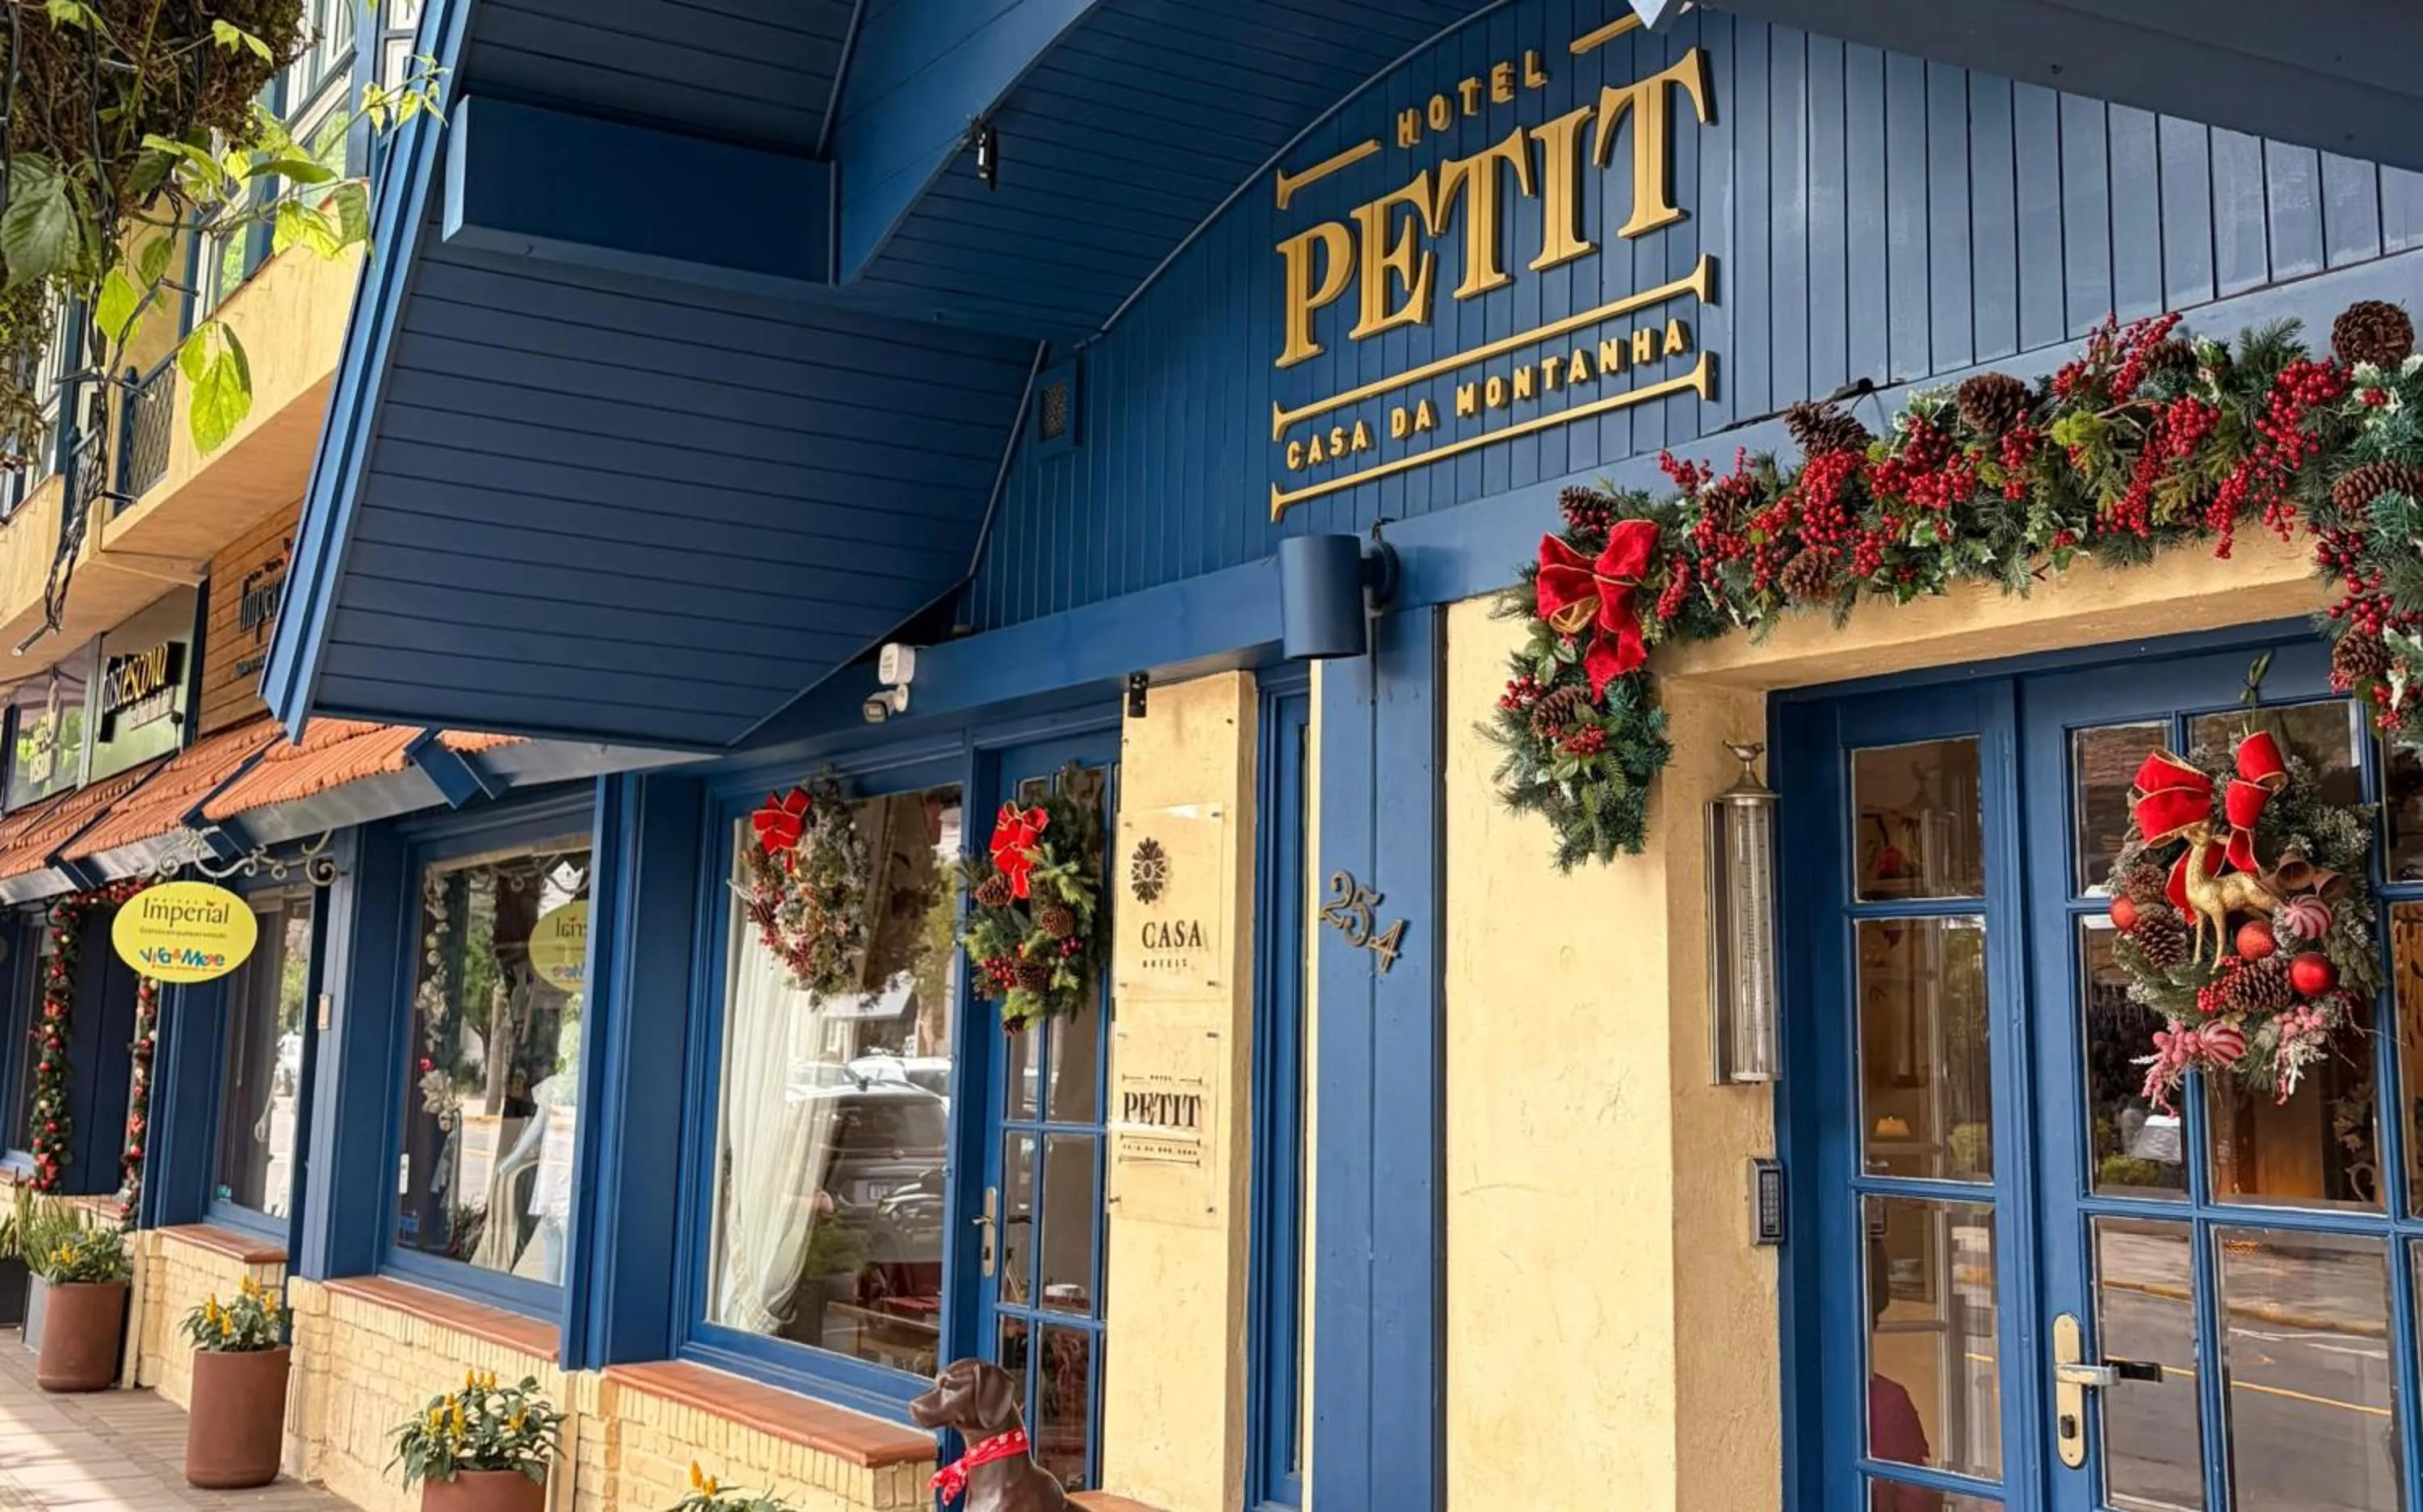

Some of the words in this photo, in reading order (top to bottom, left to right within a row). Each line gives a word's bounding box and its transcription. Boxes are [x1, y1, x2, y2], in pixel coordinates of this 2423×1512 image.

[1397, 50, 1548, 148] HOTEL
[1275, 47, 1714, 369] PETIT
[1286, 420, 1371, 471] CASA
[1391, 399, 1438, 439] DA
[1455, 318, 1690, 417] MONTANHA
[143, 897, 230, 927] Imperial
[1142, 920, 1202, 949] CASA
[1318, 871, 1407, 975] 254
[1123, 1092, 1201, 1127] PETIT
